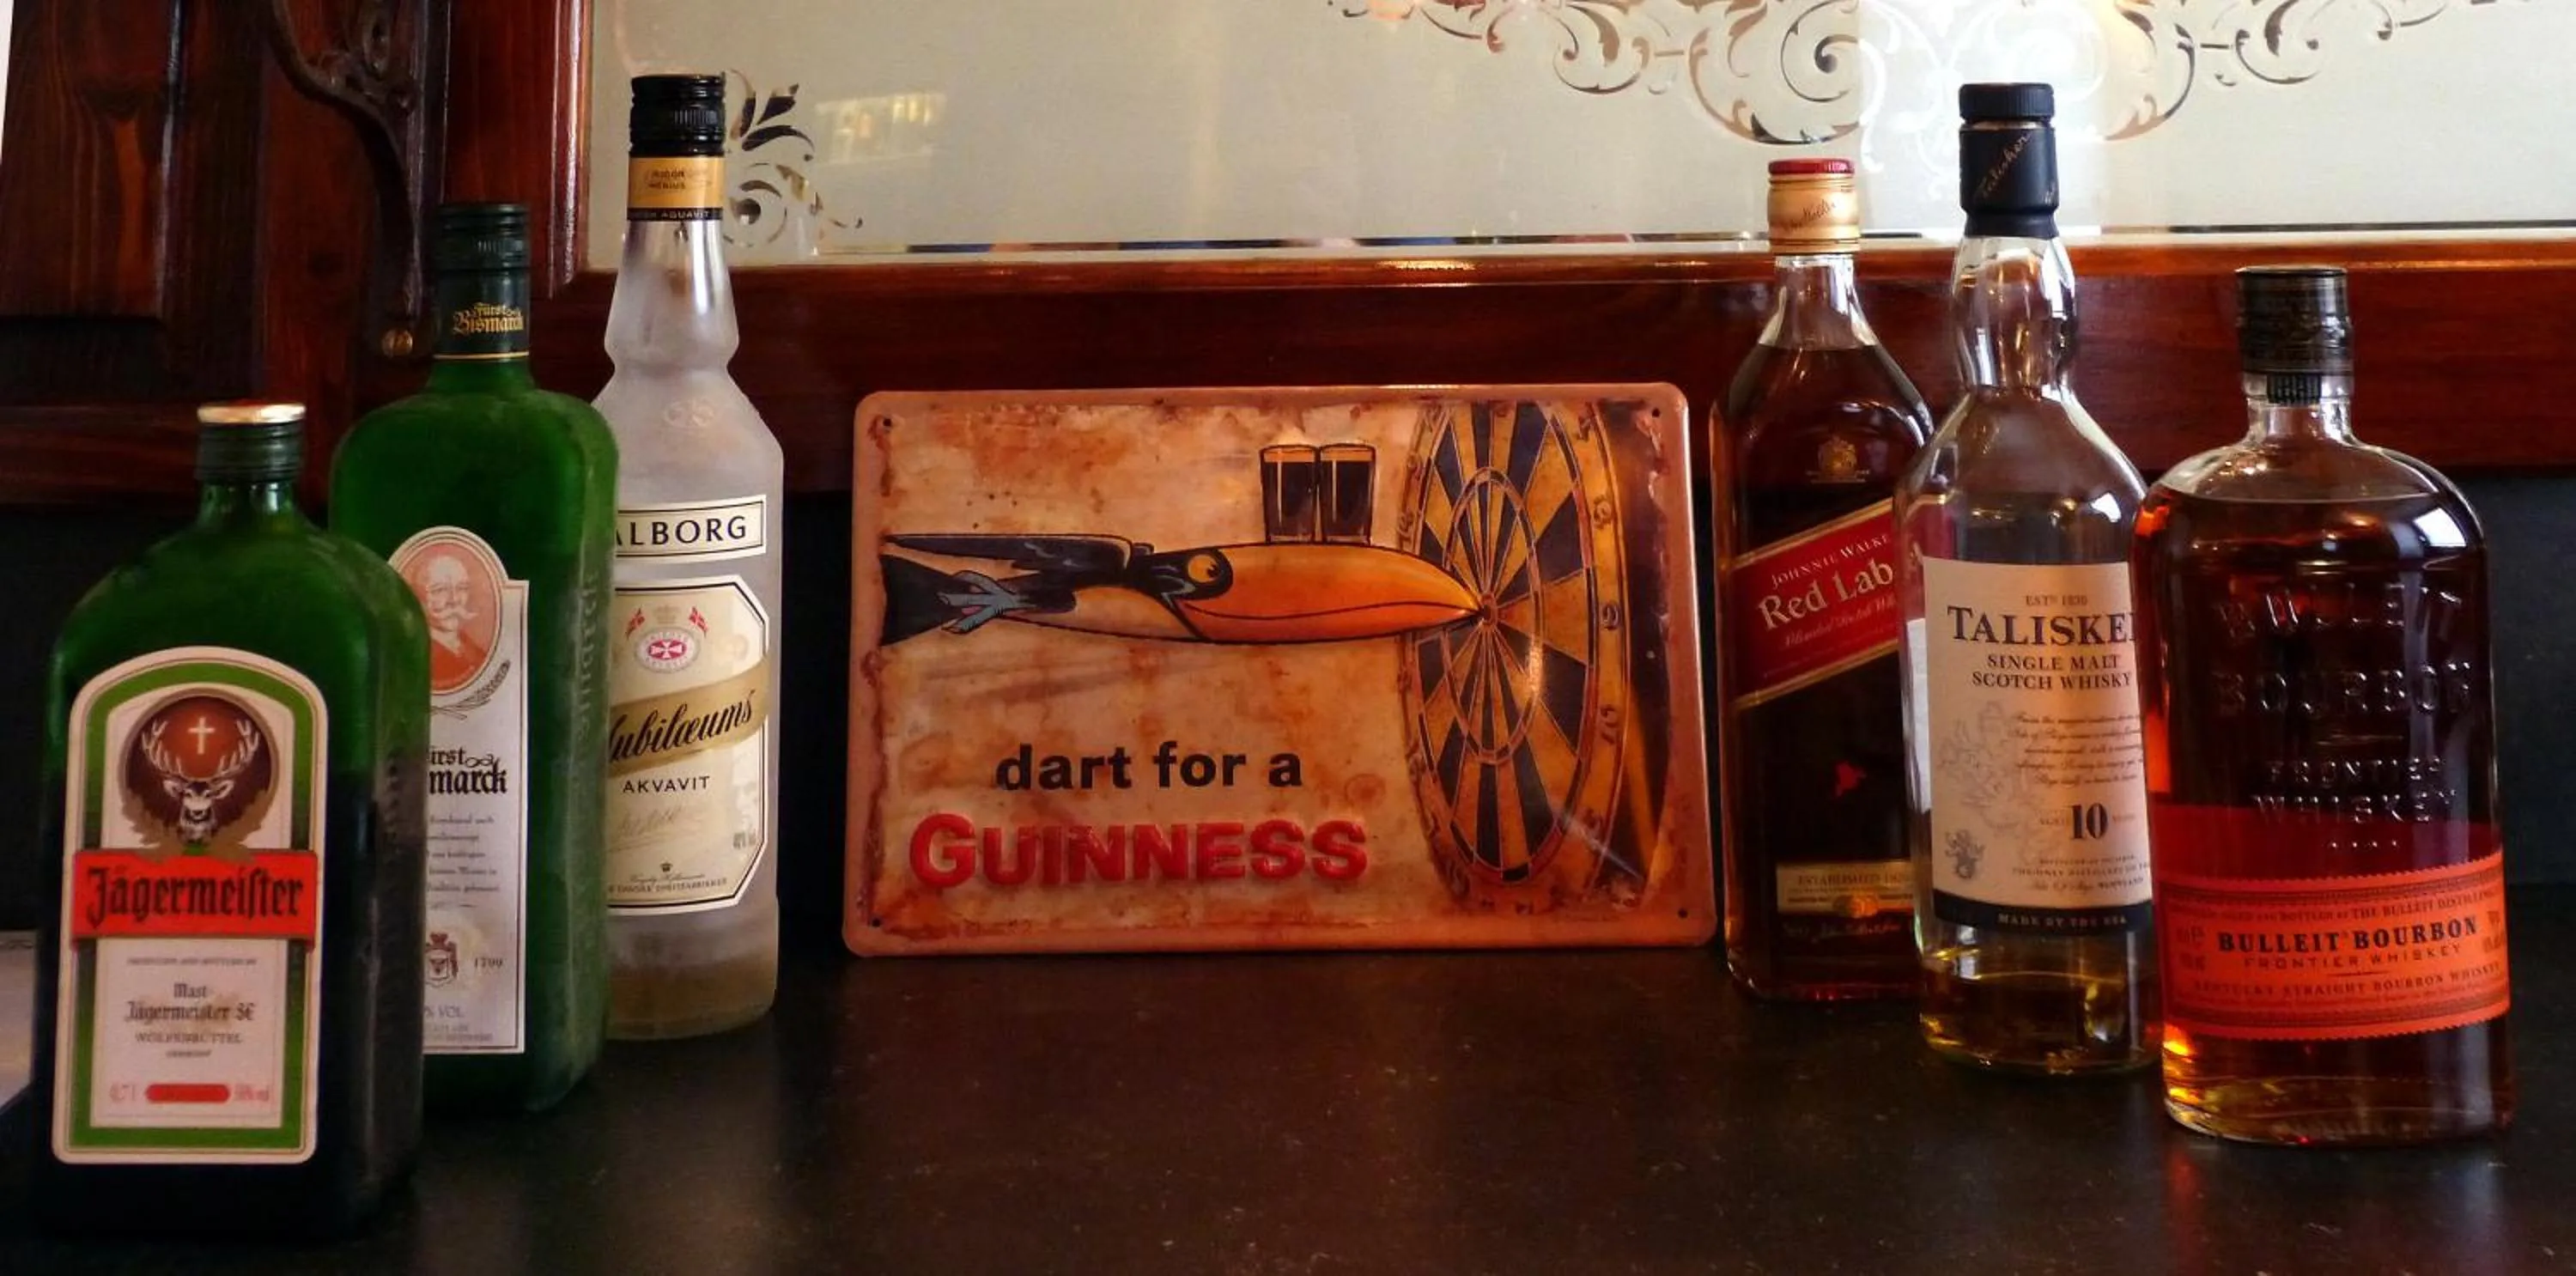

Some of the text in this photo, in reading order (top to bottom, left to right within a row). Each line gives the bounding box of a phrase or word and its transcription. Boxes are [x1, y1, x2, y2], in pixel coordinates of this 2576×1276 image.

[615, 515, 746, 547] LBORG
[1771, 534, 1889, 591] JOHNNIE WALKE
[1757, 580, 1828, 630] Red
[1832, 556, 1894, 601] Lab
[1986, 653, 2122, 671] SINGLE MALT
[1971, 671, 2133, 690] SCOTCH WHISKY
[428, 758, 508, 795] marck
[996, 740, 1303, 792] dart for a
[623, 775, 711, 794] AKVAVIT
[2069, 802, 2109, 840] 10
[908, 812, 1369, 889] GUINNESS
[1997, 913, 2041, 927] MADE
[2350, 907, 2377, 921] THE
[2217, 931, 2340, 953] BULLEIT
[2354, 915, 2477, 950] BOURBON
[2244, 955, 2360, 971] FRONTIER
[2371, 943, 2462, 966] WHISKEY
[2373, 974, 2444, 992] BOURBON
